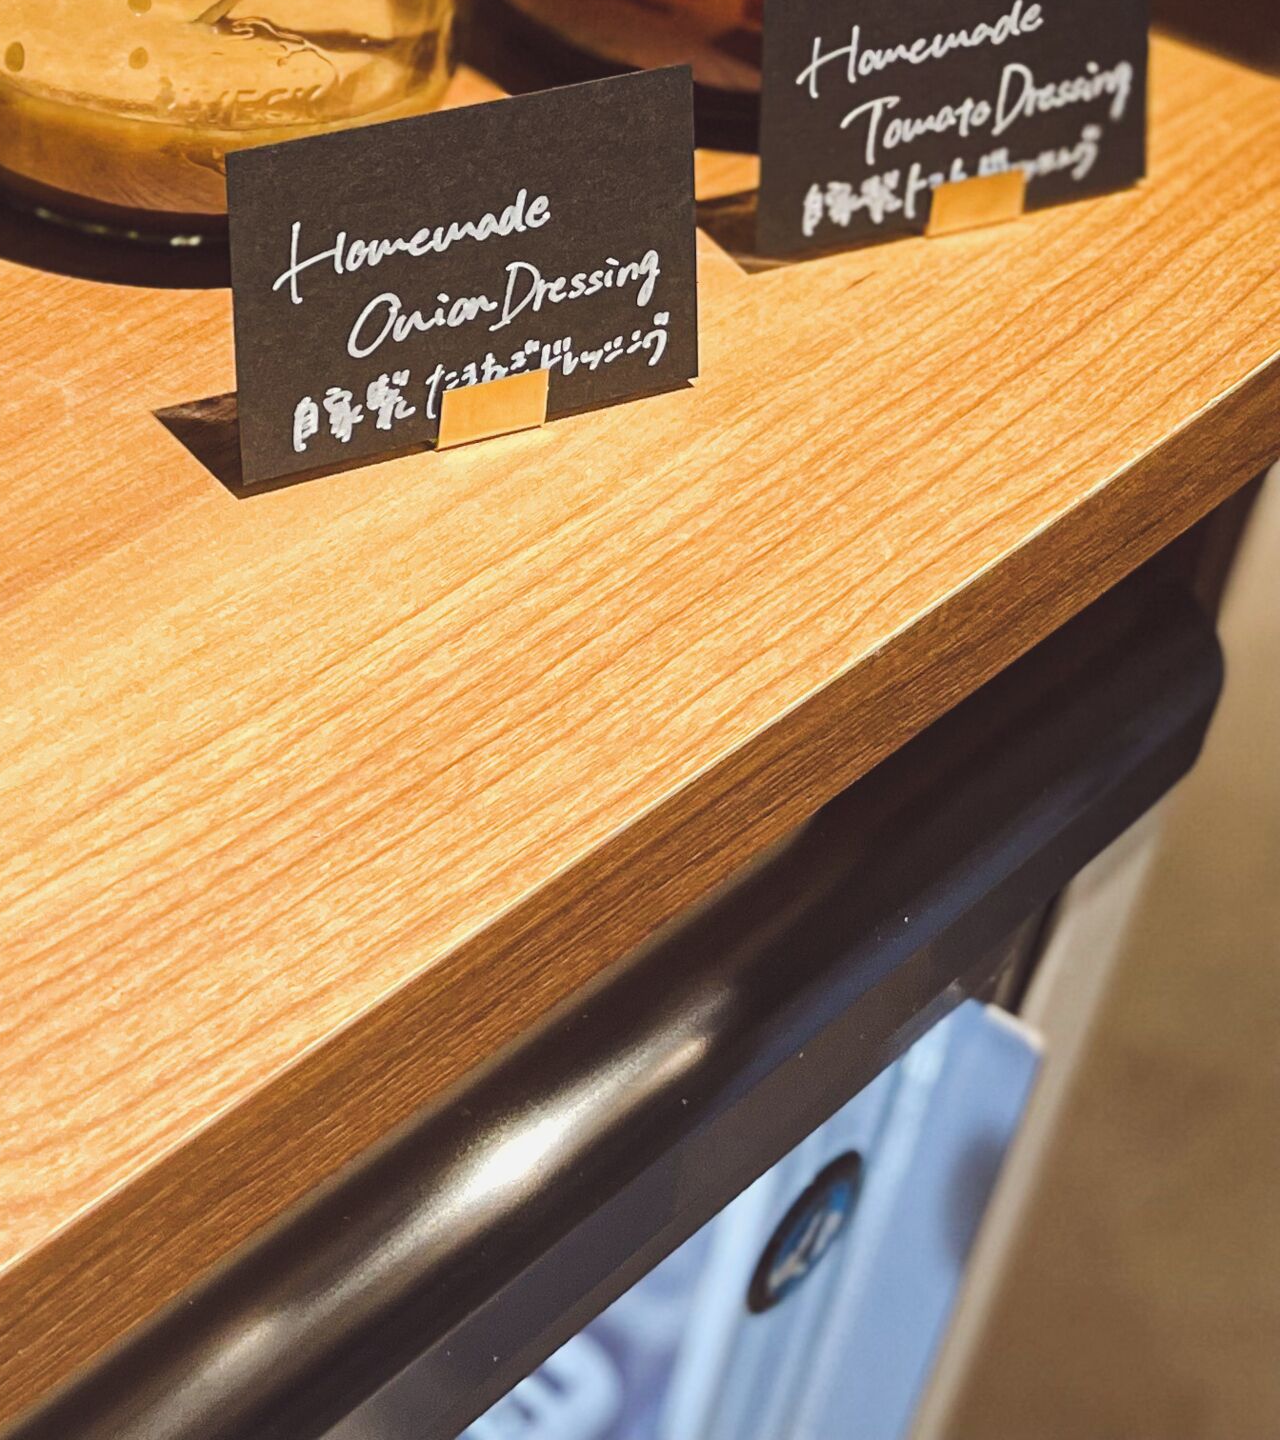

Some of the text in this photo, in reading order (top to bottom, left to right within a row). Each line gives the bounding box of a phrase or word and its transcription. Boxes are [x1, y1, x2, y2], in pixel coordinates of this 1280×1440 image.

[796, 0, 1044, 99] Homemade
[840, 62, 1134, 165] Tomato Dressing
[272, 188, 551, 305] Homemade
[347, 250, 660, 358] Onion Dressing
